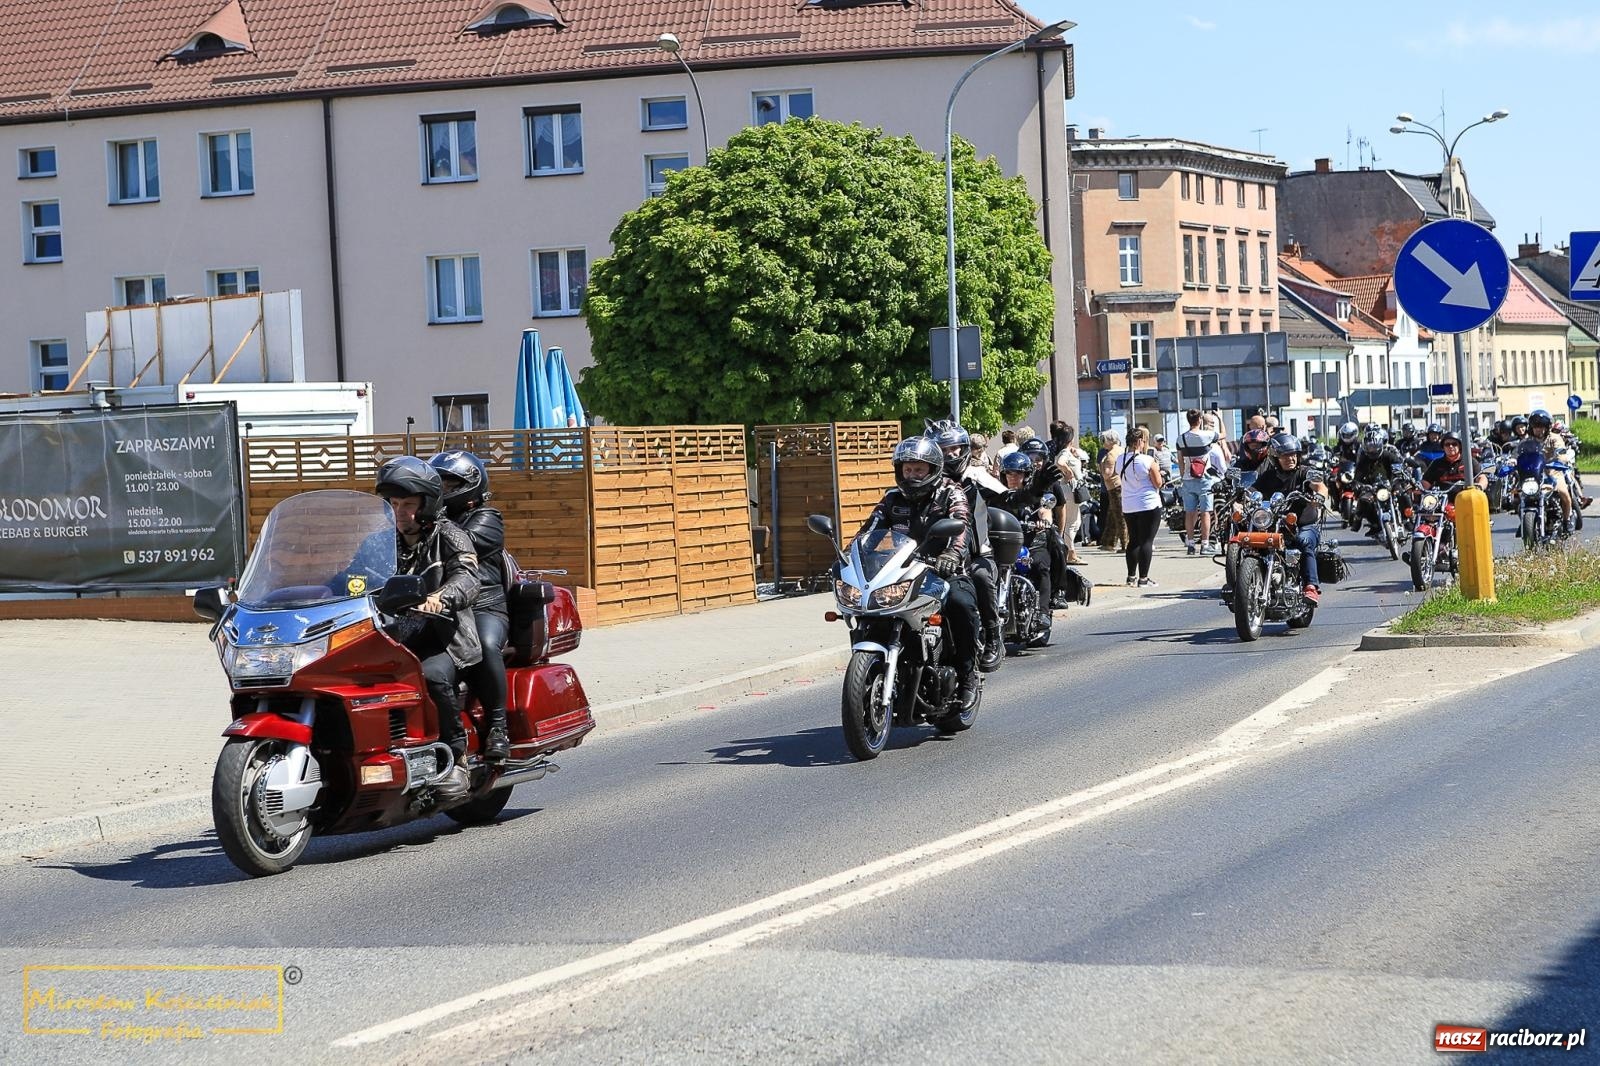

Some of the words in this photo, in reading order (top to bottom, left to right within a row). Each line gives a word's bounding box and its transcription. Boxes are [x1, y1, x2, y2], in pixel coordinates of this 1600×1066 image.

[115, 435, 216, 454] ZAPRASZAMY!
[124, 469, 177, 482] poniedziałek
[183, 468, 213, 479] sobota
[125, 482, 149, 493] 11.00
[156, 481, 180, 492] 23.00
[0, 495, 108, 522] ŁODOMOR
[127, 506, 164, 516] niedziela
[128, 518, 152, 528] 15.00
[158, 517, 183, 527] 22.00
[33, 527, 42, 538] &
[44, 525, 89, 538] BURGER
[138, 550, 161, 563] 537
[164, 549, 188, 562] 891
[190, 548, 215, 561] 962
